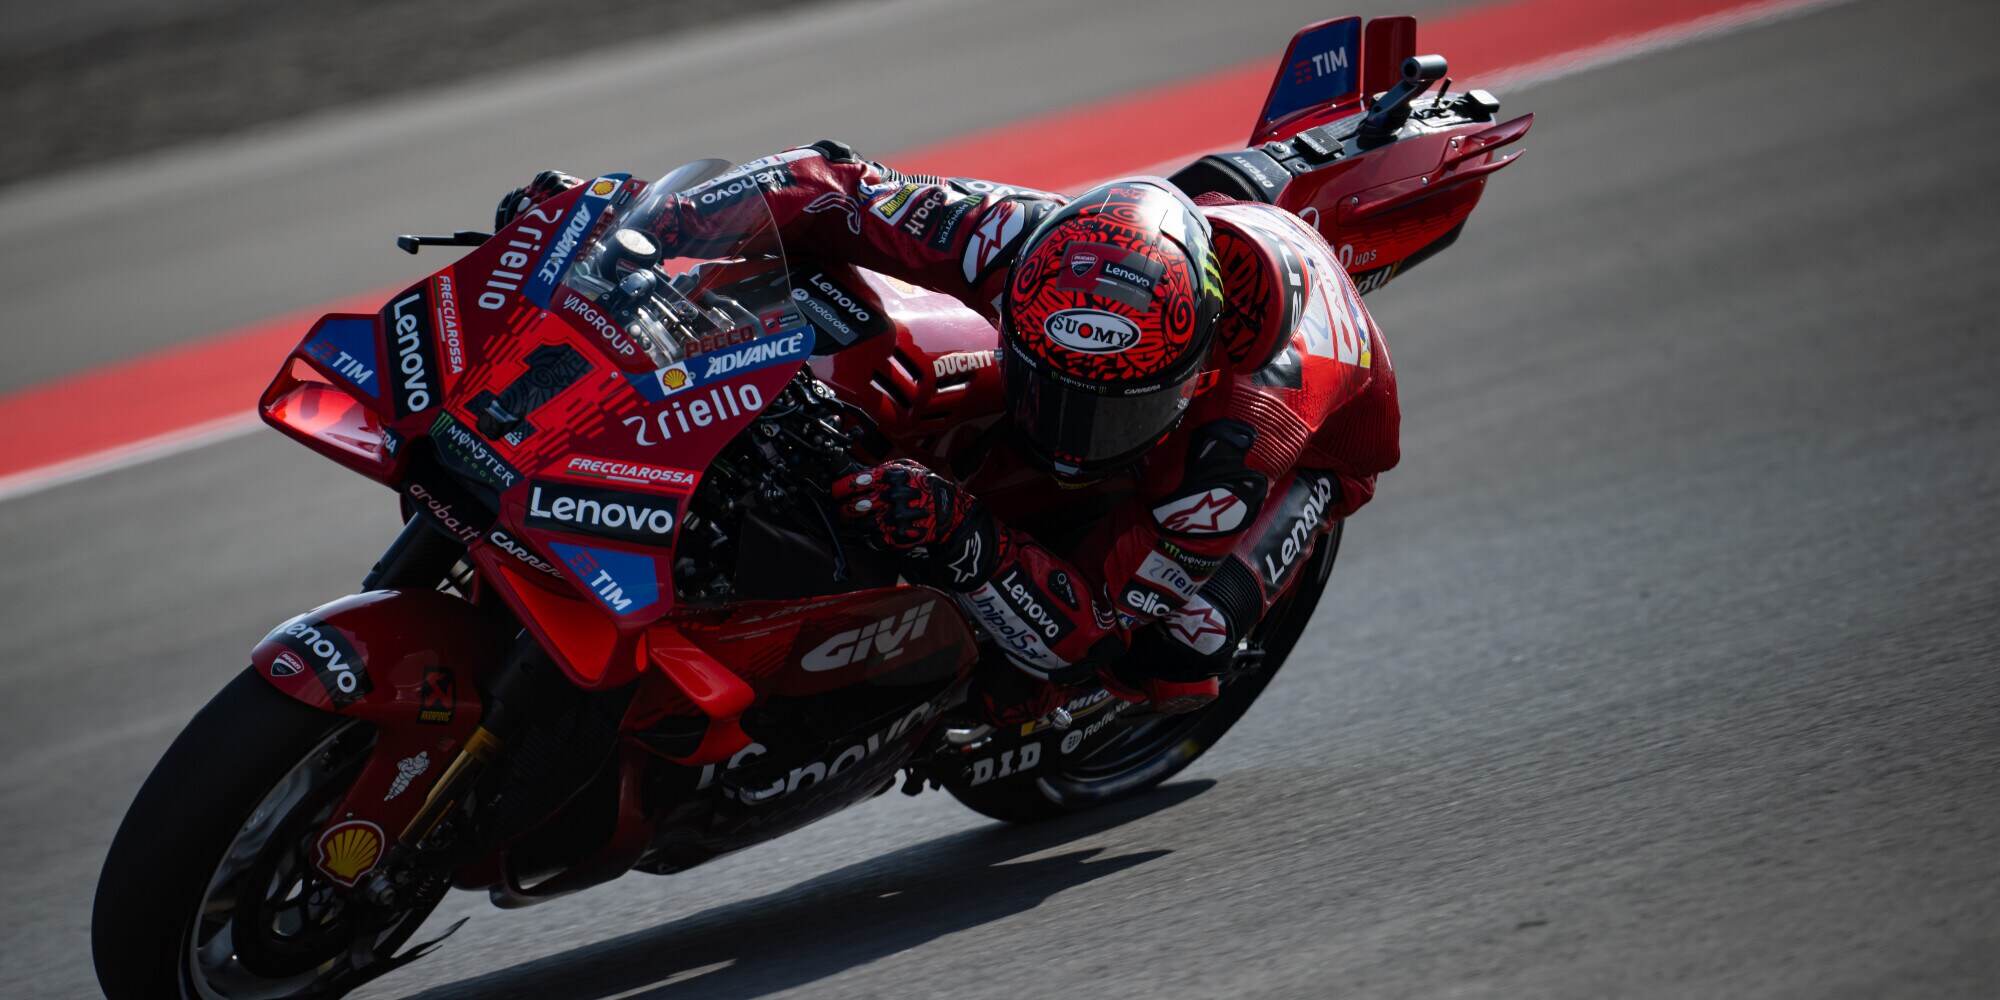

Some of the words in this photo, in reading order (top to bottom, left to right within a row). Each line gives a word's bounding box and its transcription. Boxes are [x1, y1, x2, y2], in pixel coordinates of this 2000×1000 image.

[1312, 46, 1348, 78] TIM
[700, 168, 786, 204] Lenovo
[538, 202, 592, 286] ADVANCE
[1354, 249, 1377, 266] ups
[478, 226, 543, 310] riello
[1105, 263, 1150, 287] Lenovo
[806, 299, 851, 335] motorola
[810, 272, 870, 322] Lenovo
[438, 275, 463, 374] FRECCIAROSSA
[1053, 315, 1131, 348] SUOMY
[332, 351, 374, 385] TIM
[393, 293, 430, 413] Lenovo
[704, 335, 801, 379] ADVANCE
[932, 350, 992, 378] DUCATI
[1124, 383, 1161, 395] CARRERA
[657, 384, 763, 440] riello
[447, 425, 515, 487] MONSTER
[448, 443, 495, 483] ENERGY
[567, 457, 694, 485] FRECCIAROSSA
[530, 487, 674, 534] Lenovo
[1265, 477, 1332, 585] Lenovo
[490, 531, 567, 580] CARRER
[591, 569, 633, 612] TIM
[1160, 567, 1199, 596] riell
[1001, 570, 1059, 638] Lenovo
[280, 621, 357, 694] enovo
[970, 741, 1042, 787] D.I.D
